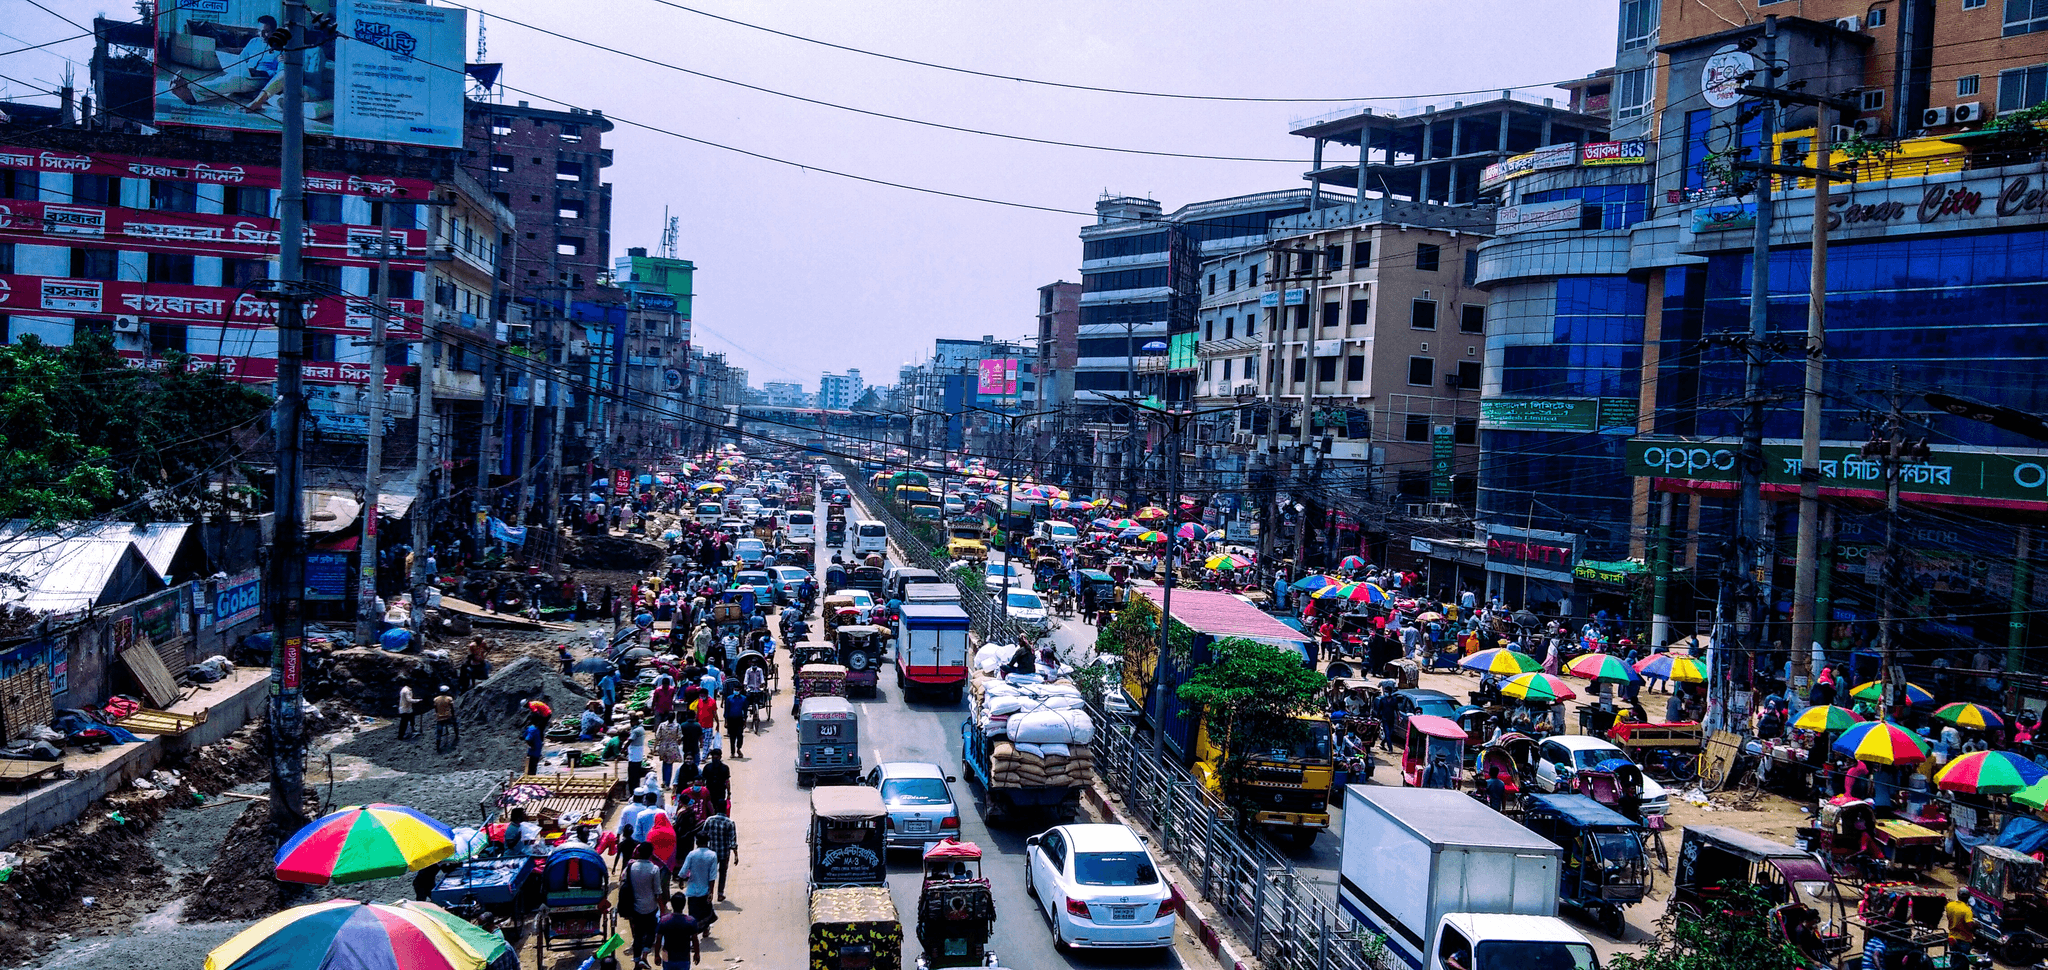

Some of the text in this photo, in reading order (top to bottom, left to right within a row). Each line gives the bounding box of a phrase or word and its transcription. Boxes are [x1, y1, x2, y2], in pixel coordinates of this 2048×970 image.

[355, 20, 391, 35] সবার
[374, 31, 417, 54] বাড়ি
[1585, 143, 1620, 159] ওরাকল
[1620, 141, 1644, 157] BCS
[40, 152, 92, 171] সিমেন্ট
[195, 164, 246, 182] সিমেন্ট
[1917, 183, 1982, 224] City
[121, 293, 226, 316] বসুন্ধরা
[820, 725, 837, 735] الله
